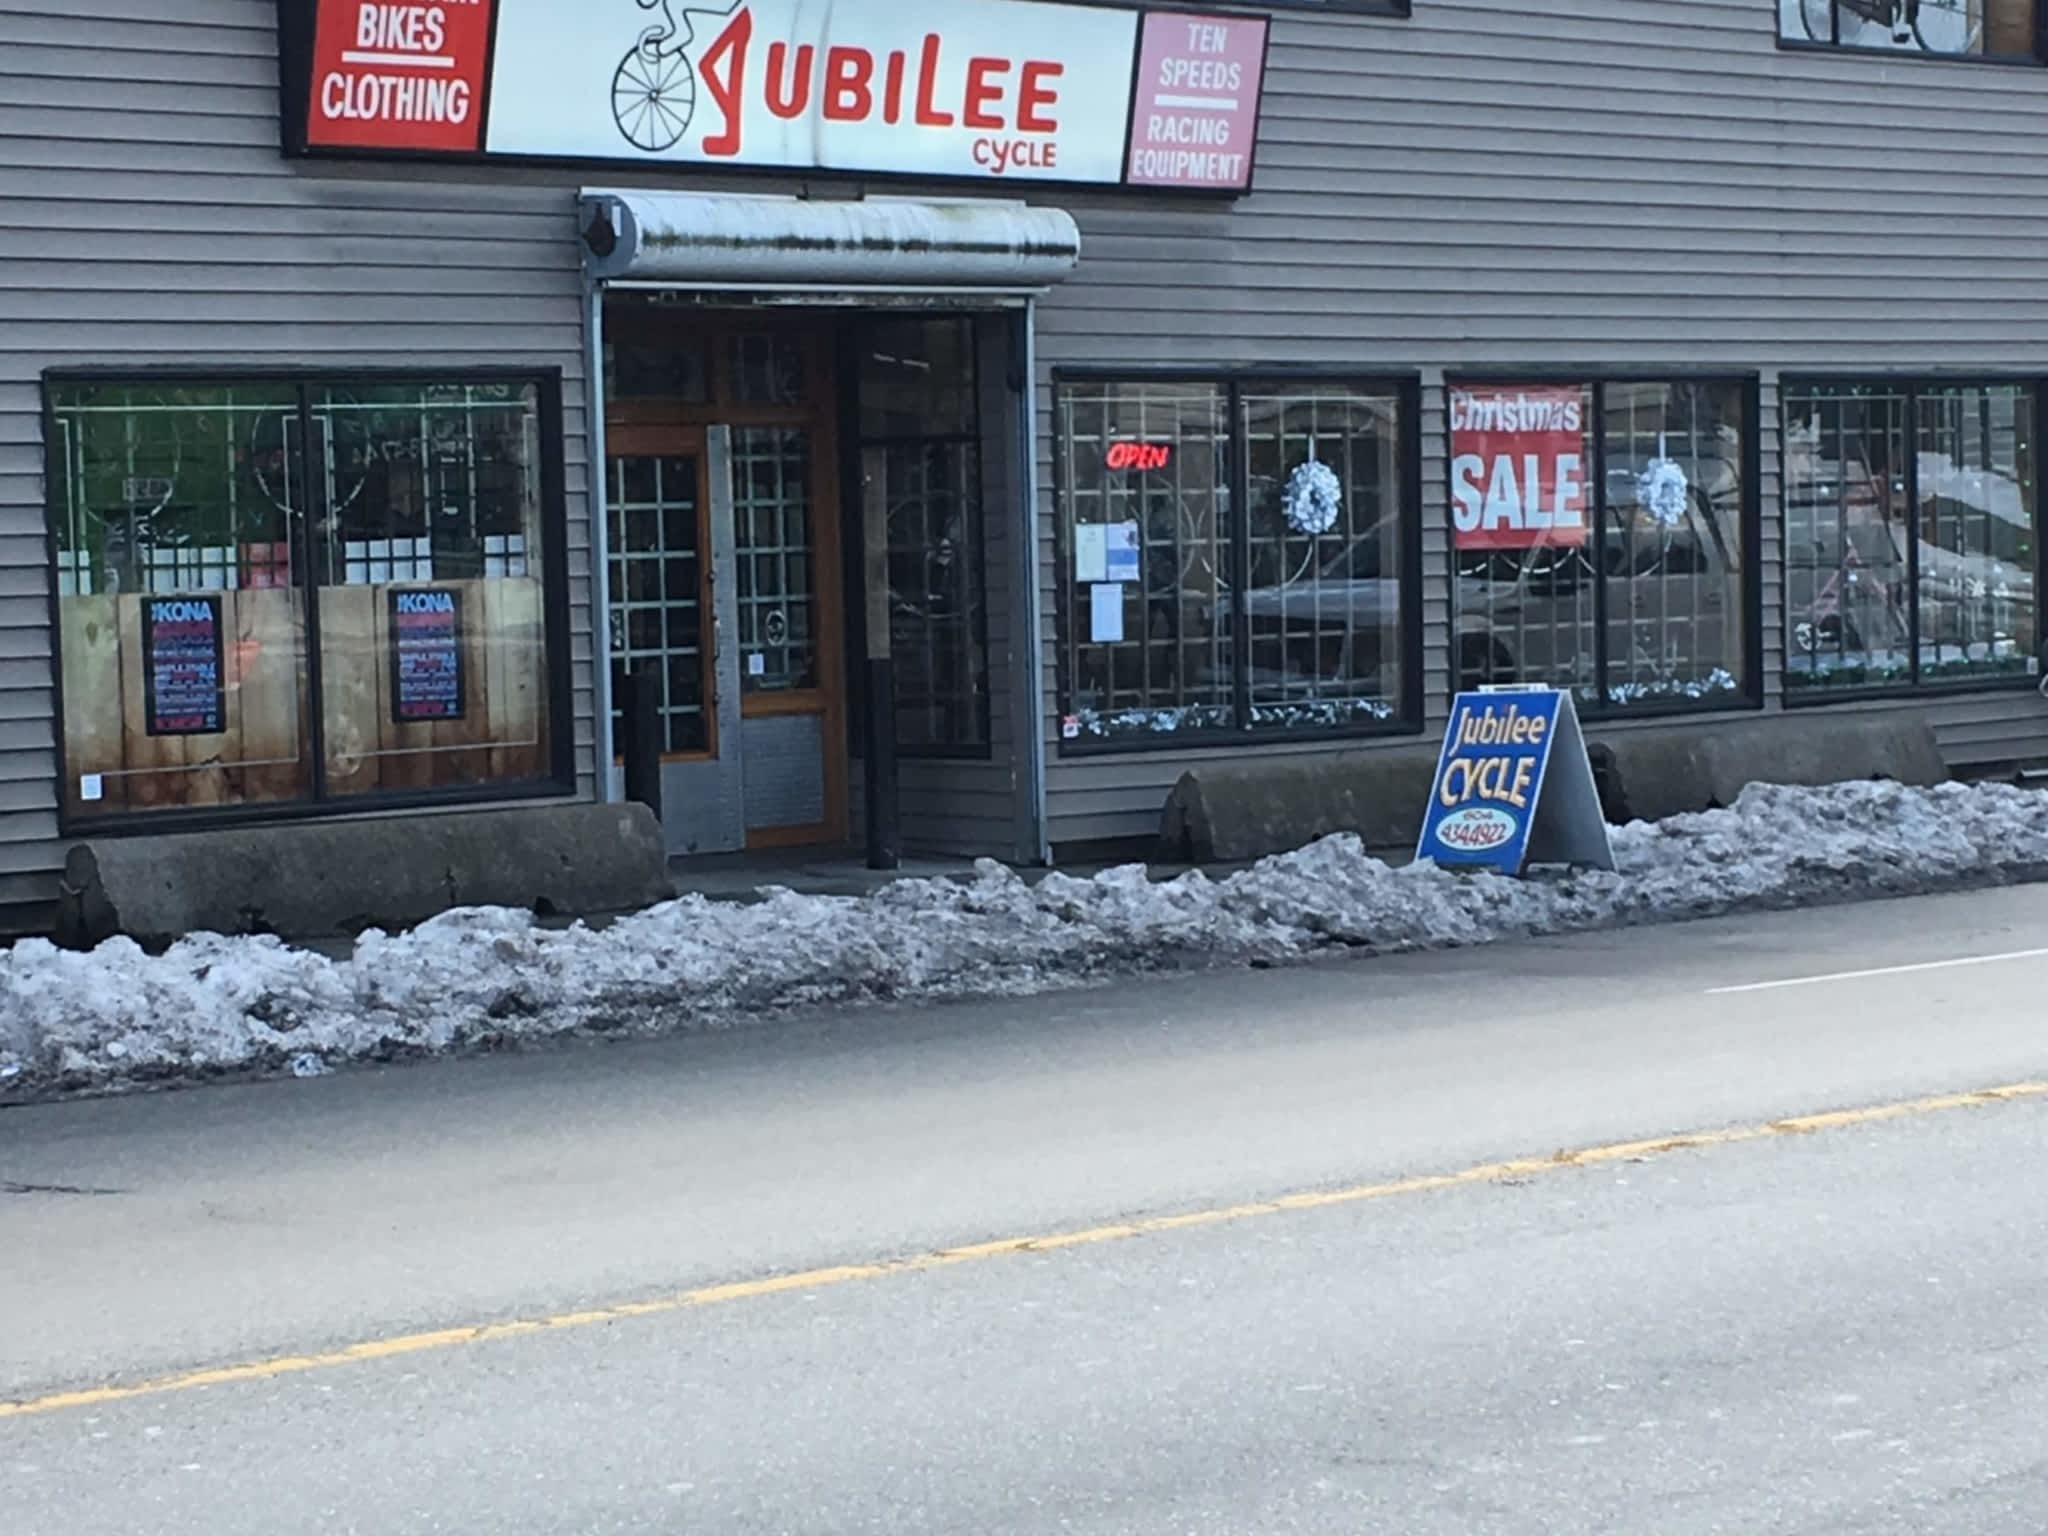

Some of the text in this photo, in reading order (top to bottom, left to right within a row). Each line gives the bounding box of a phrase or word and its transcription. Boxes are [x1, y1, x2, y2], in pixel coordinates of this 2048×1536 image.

[357, 3, 445, 51] BIKES
[1188, 23, 1228, 53] TEN
[1159, 57, 1241, 90] SPEEDS
[321, 73, 470, 123] CLOTHING
[1147, 115, 1229, 145] RACING
[1132, 149, 1243, 181] EQUIPMENT
[1450, 391, 1580, 432] Christmas
[1106, 442, 1169, 470] OPEN
[1452, 453, 1583, 532] SALE
[1448, 703, 1546, 756] Jubilee
[1440, 757, 1536, 809] CYCLE
